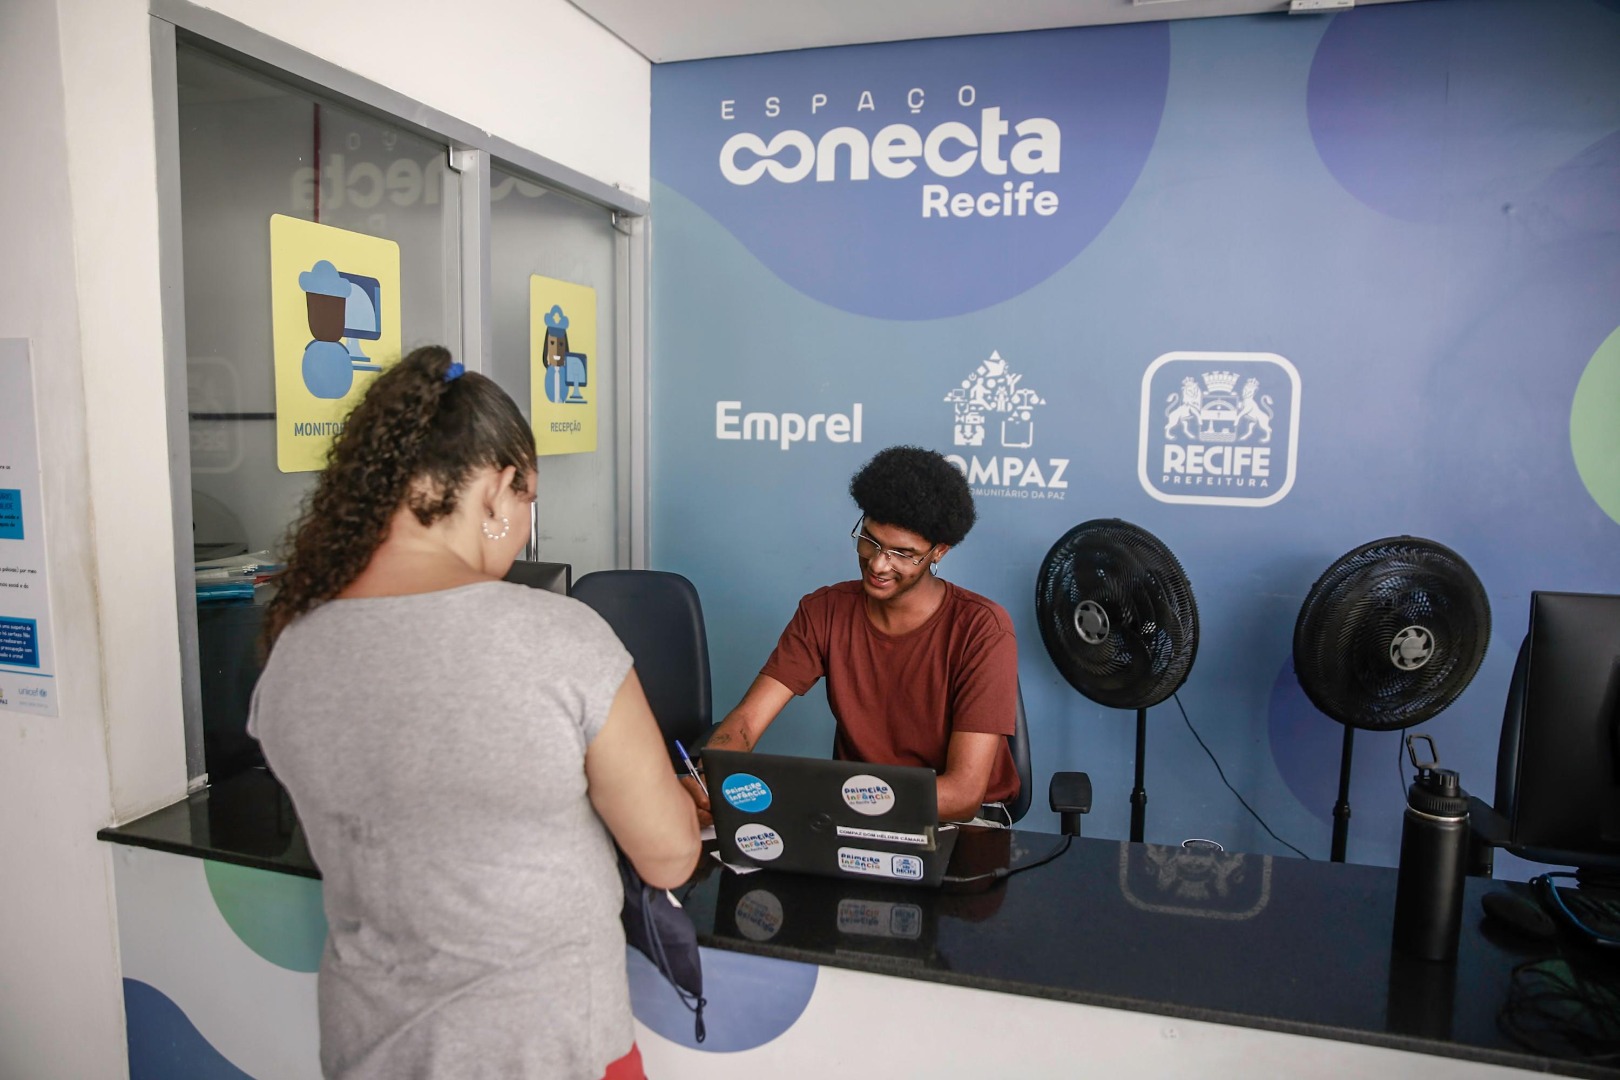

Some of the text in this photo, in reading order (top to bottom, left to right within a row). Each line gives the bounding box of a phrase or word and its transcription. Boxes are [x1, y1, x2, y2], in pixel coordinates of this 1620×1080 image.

[721, 85, 976, 119] ESPAÇO
[719, 106, 1061, 186] conecta
[922, 181, 1060, 218] Recife
[550, 419, 582, 435] RECEPÇÃO
[716, 401, 863, 451] Emprel
[943, 454, 1070, 489] OMPAZ
[1163, 444, 1271, 477] RECIFE
[970, 487, 1066, 500] OMUNITÁRIO DA PAZ
[1162, 475, 1269, 488] PREFEITURA
